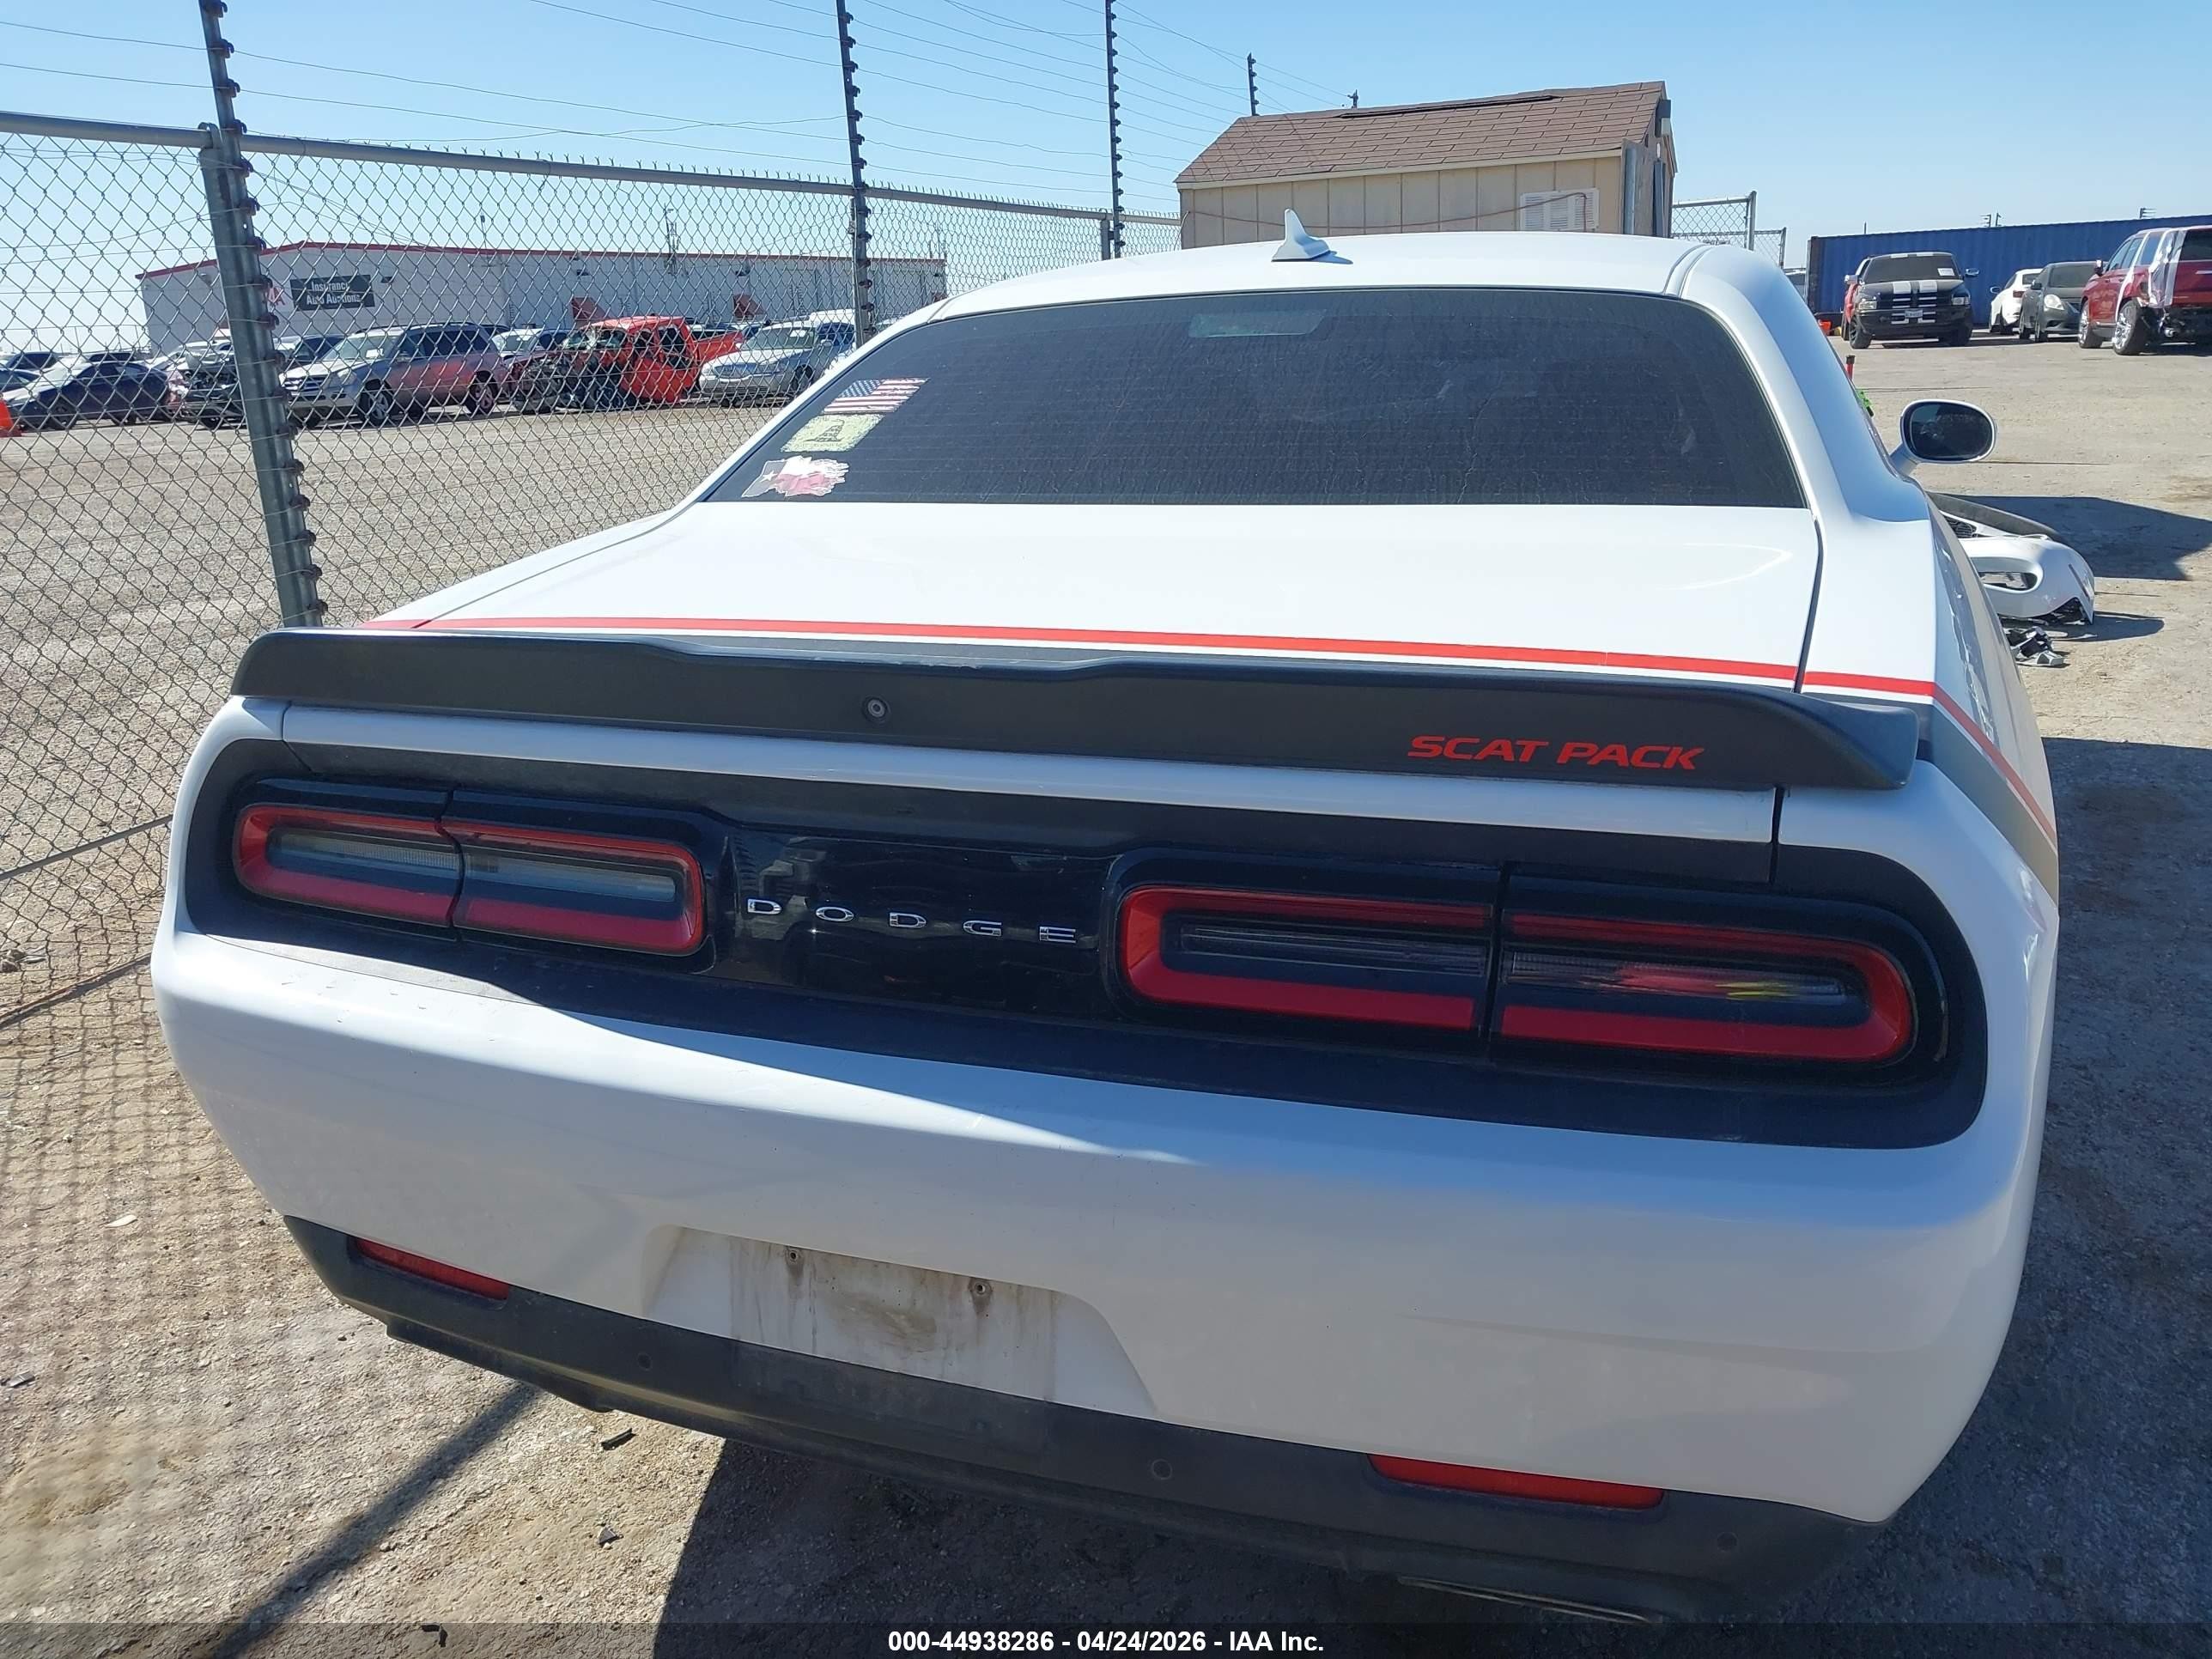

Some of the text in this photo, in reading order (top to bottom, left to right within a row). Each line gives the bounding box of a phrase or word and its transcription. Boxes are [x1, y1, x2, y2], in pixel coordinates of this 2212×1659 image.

[1407, 735, 1705, 770] SCAT PACK
[746, 898, 1077, 943] DODGE
